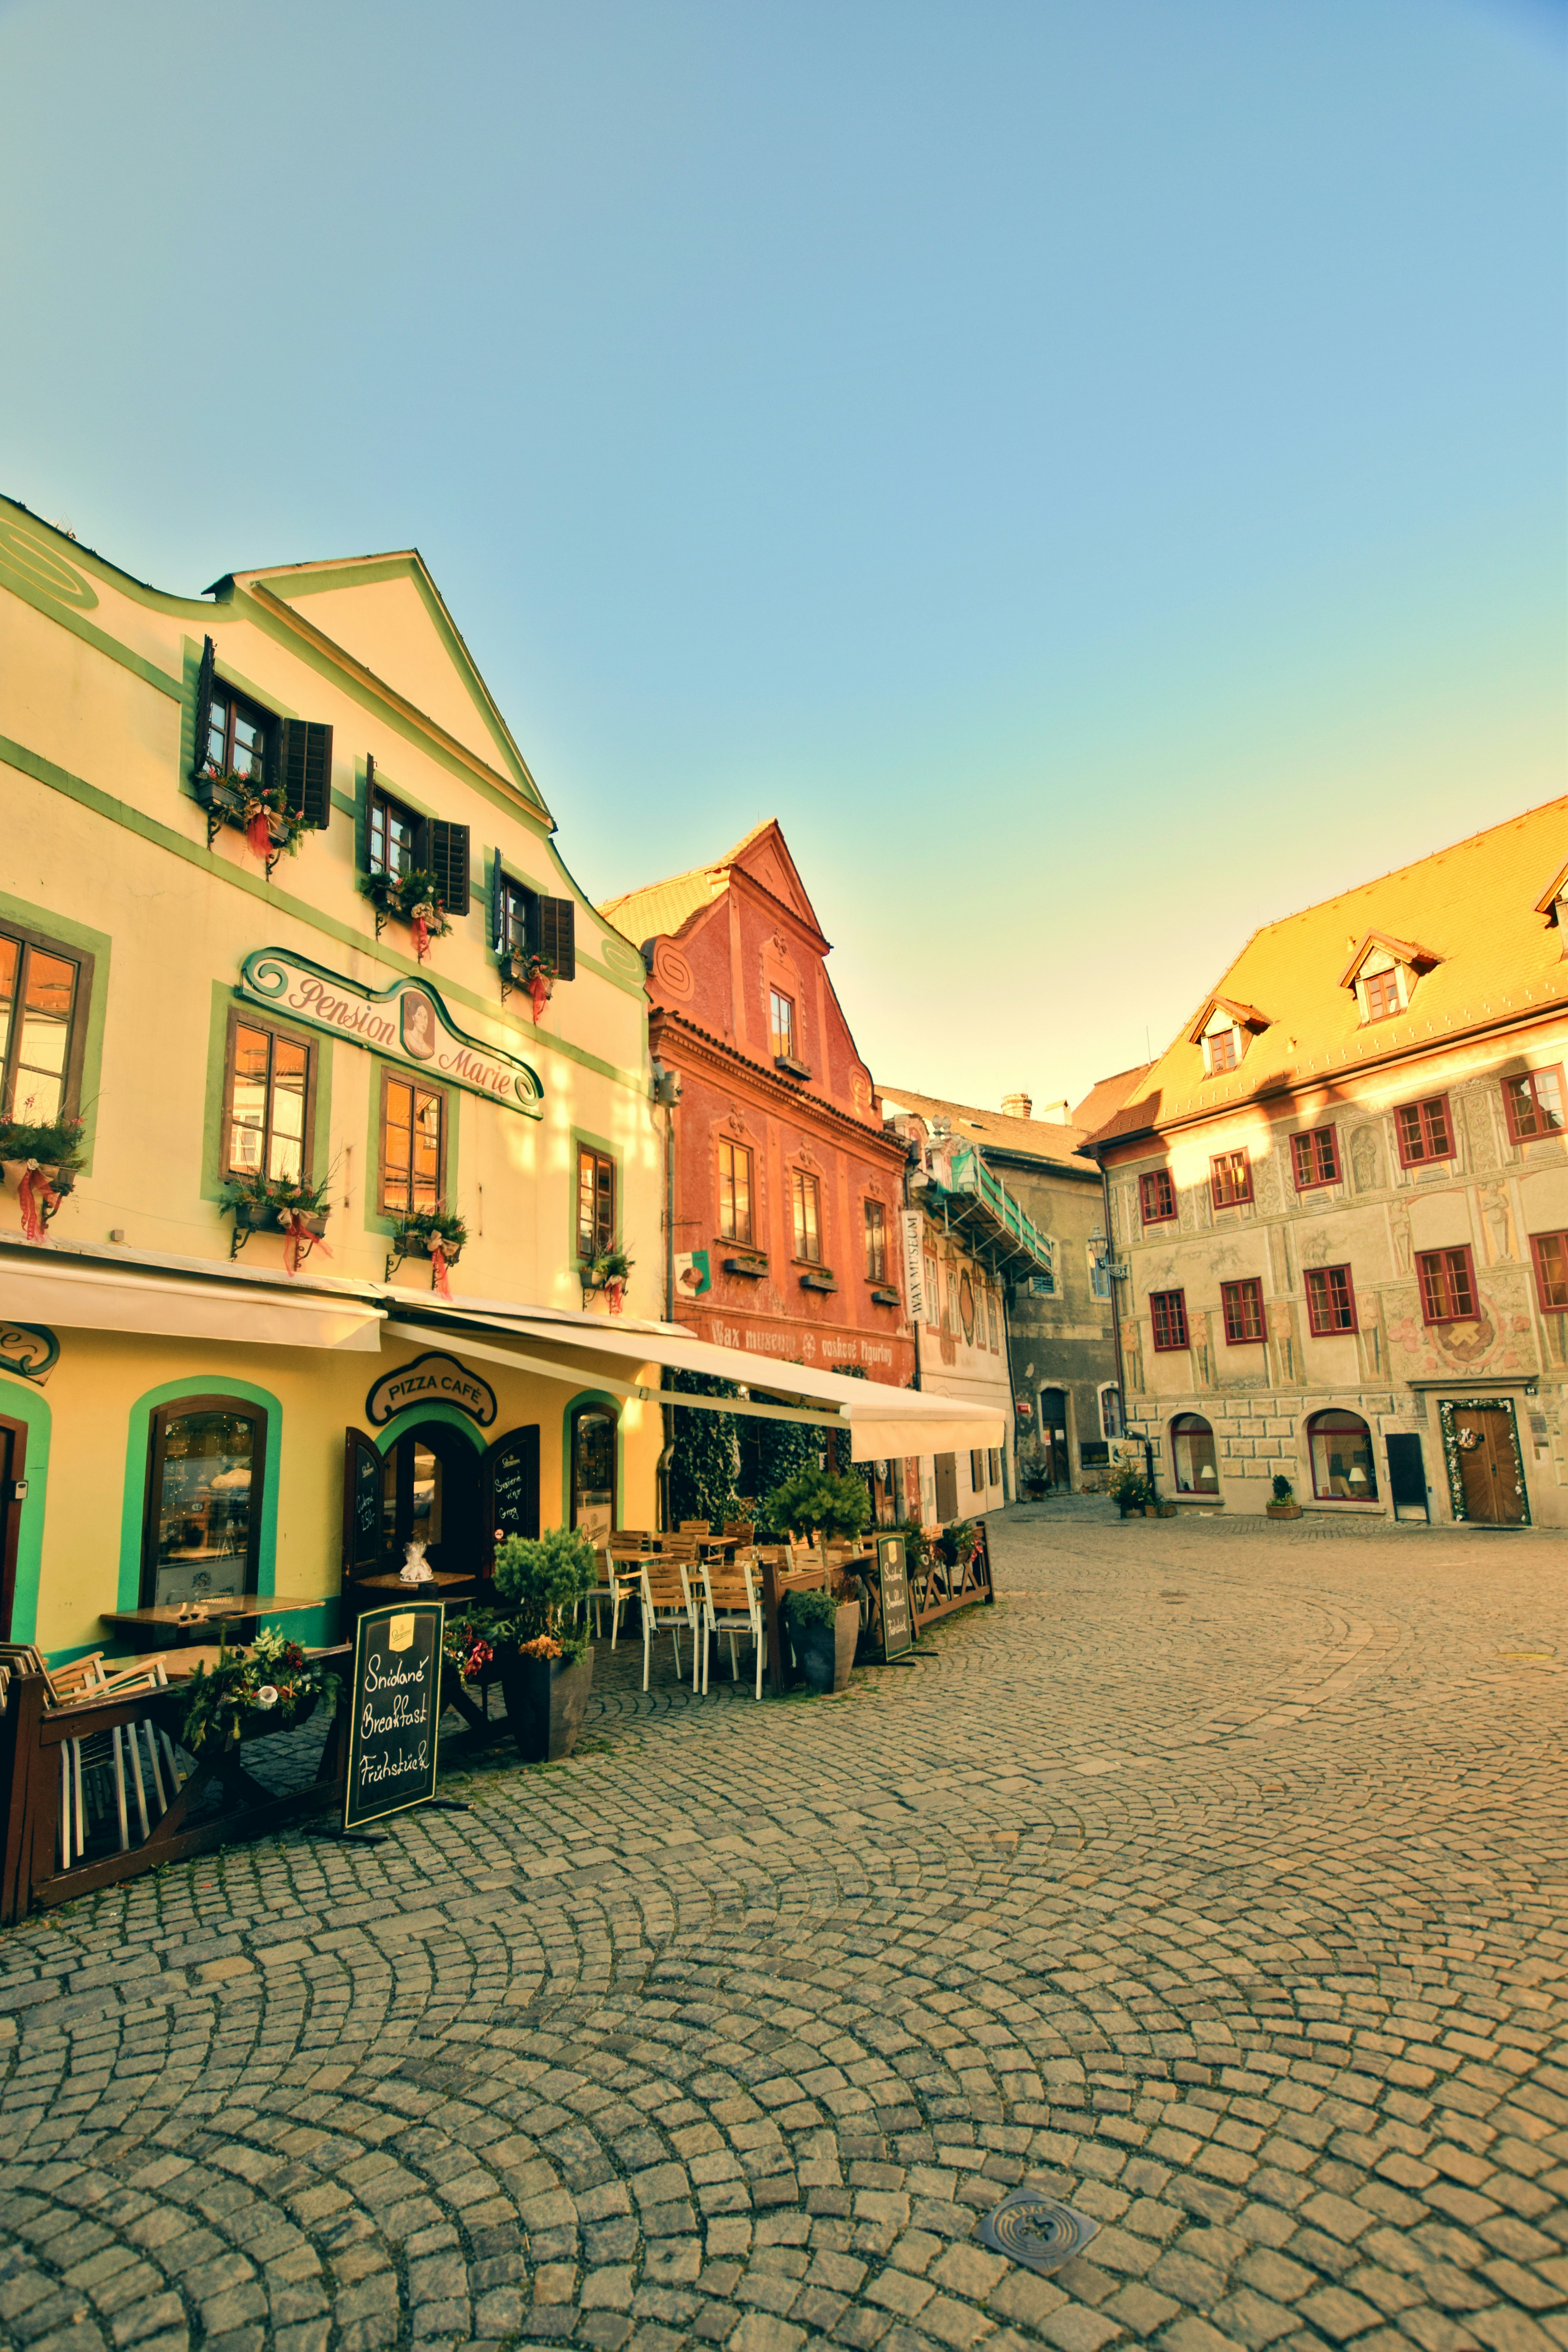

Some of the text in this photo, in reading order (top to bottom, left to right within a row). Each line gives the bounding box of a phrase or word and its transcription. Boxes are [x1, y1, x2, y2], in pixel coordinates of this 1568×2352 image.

[289, 979, 510, 1094] Pension Marie
[907, 1217, 922, 1313] WAX MUSEUM
[711, 1319, 740, 1348] Wax
[389, 1376, 481, 1404] PIZZA CAFÉ
[499, 1507, 519, 1519] Grog
[361, 1693, 427, 1739] Breakfast
[359, 1740, 430, 1785] Frühstück
